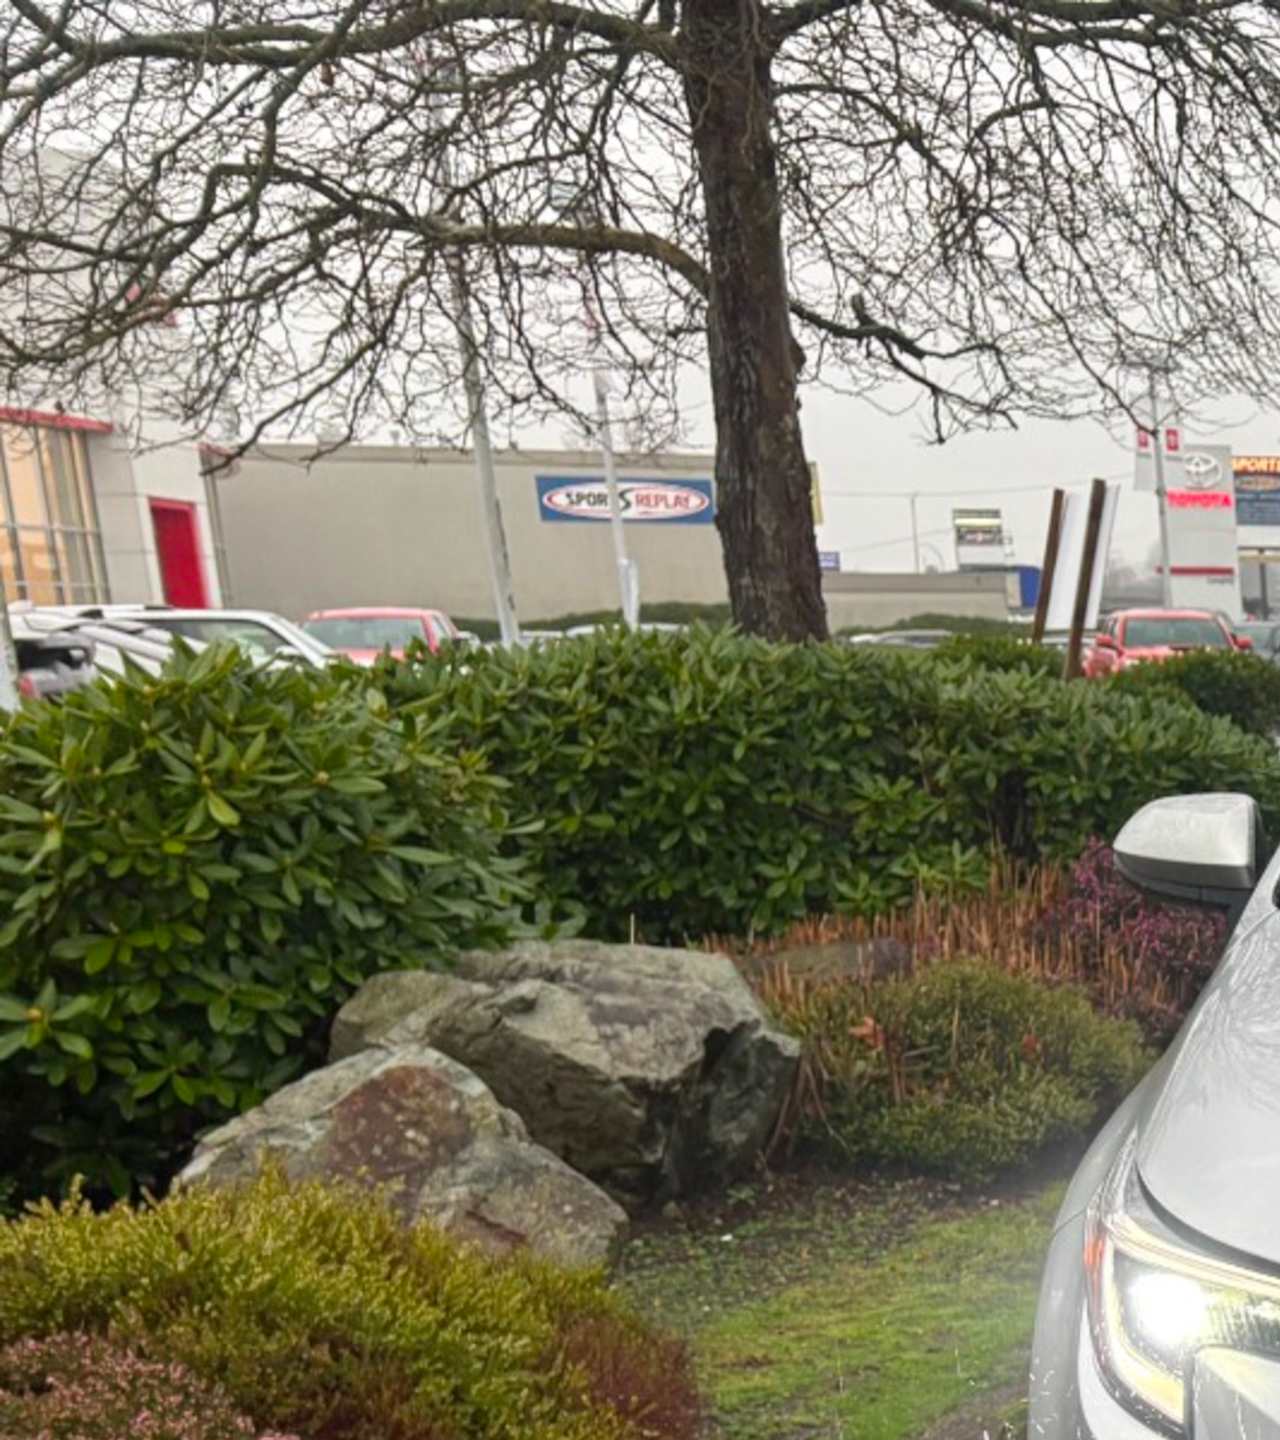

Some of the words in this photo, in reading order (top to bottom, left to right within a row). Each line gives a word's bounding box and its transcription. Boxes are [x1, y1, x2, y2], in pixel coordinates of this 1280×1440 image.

[565, 487, 632, 512] SPORS
[634, 492, 690, 510] REPLAY
[1167, 490, 1233, 510] TOYOTA
